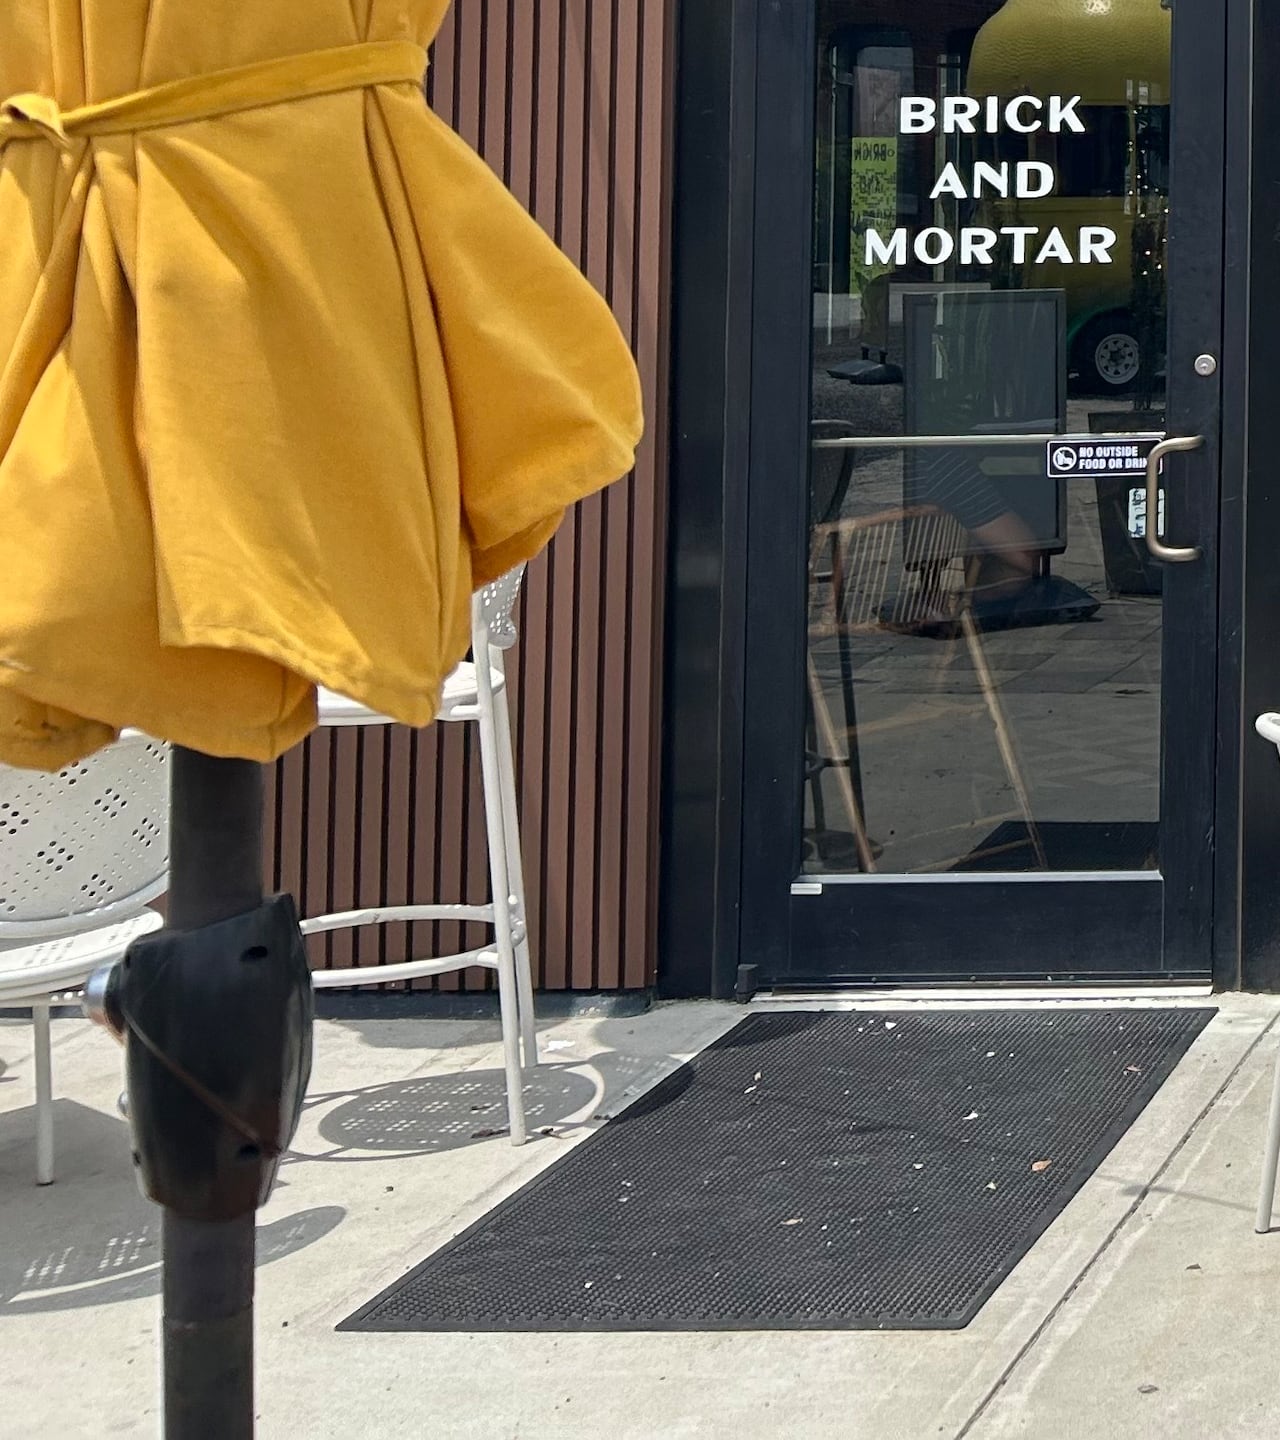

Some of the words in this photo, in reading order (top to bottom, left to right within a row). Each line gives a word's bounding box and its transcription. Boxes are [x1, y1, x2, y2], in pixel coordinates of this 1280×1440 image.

[899, 95, 1087, 134] BRICK
[929, 160, 1056, 200] AND
[864, 226, 1117, 266] MORTAR
[1079, 447, 1094, 458] NO
[1096, 446, 1138, 458] OUTSIDE
[1079, 459, 1106, 470] FOOD
[1108, 458, 1123, 469] OR
